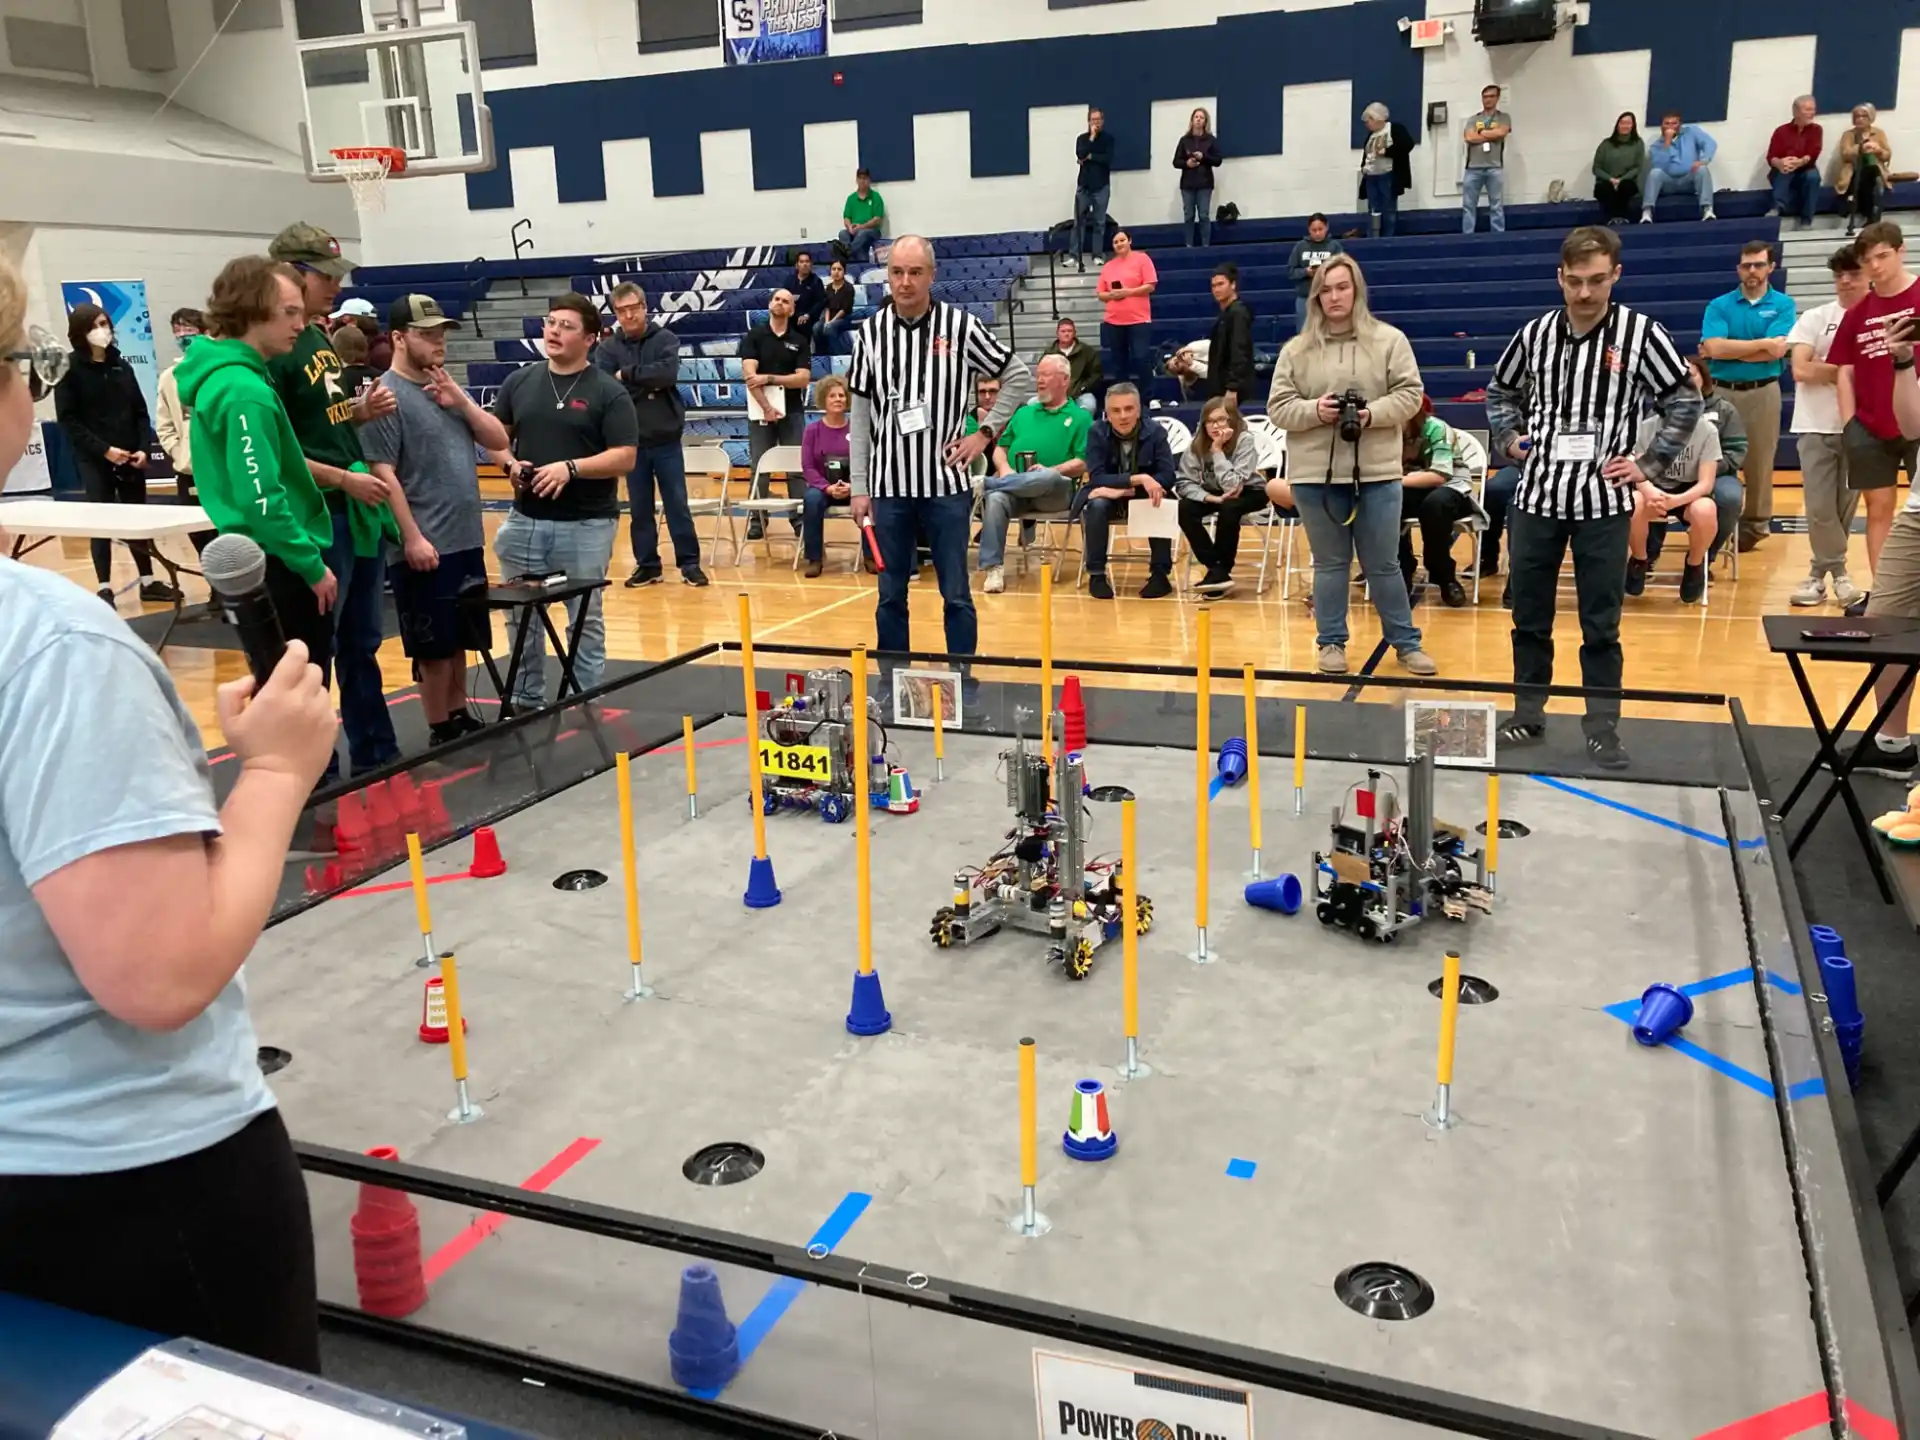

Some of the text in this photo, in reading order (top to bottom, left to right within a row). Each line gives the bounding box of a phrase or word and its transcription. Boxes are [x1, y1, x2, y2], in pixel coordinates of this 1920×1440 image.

[768, 4, 825, 34] THE NEST
[239, 414, 268, 516] 12517
[759, 749, 828, 774] 11841
[1058, 1400, 1134, 1440] POWER
